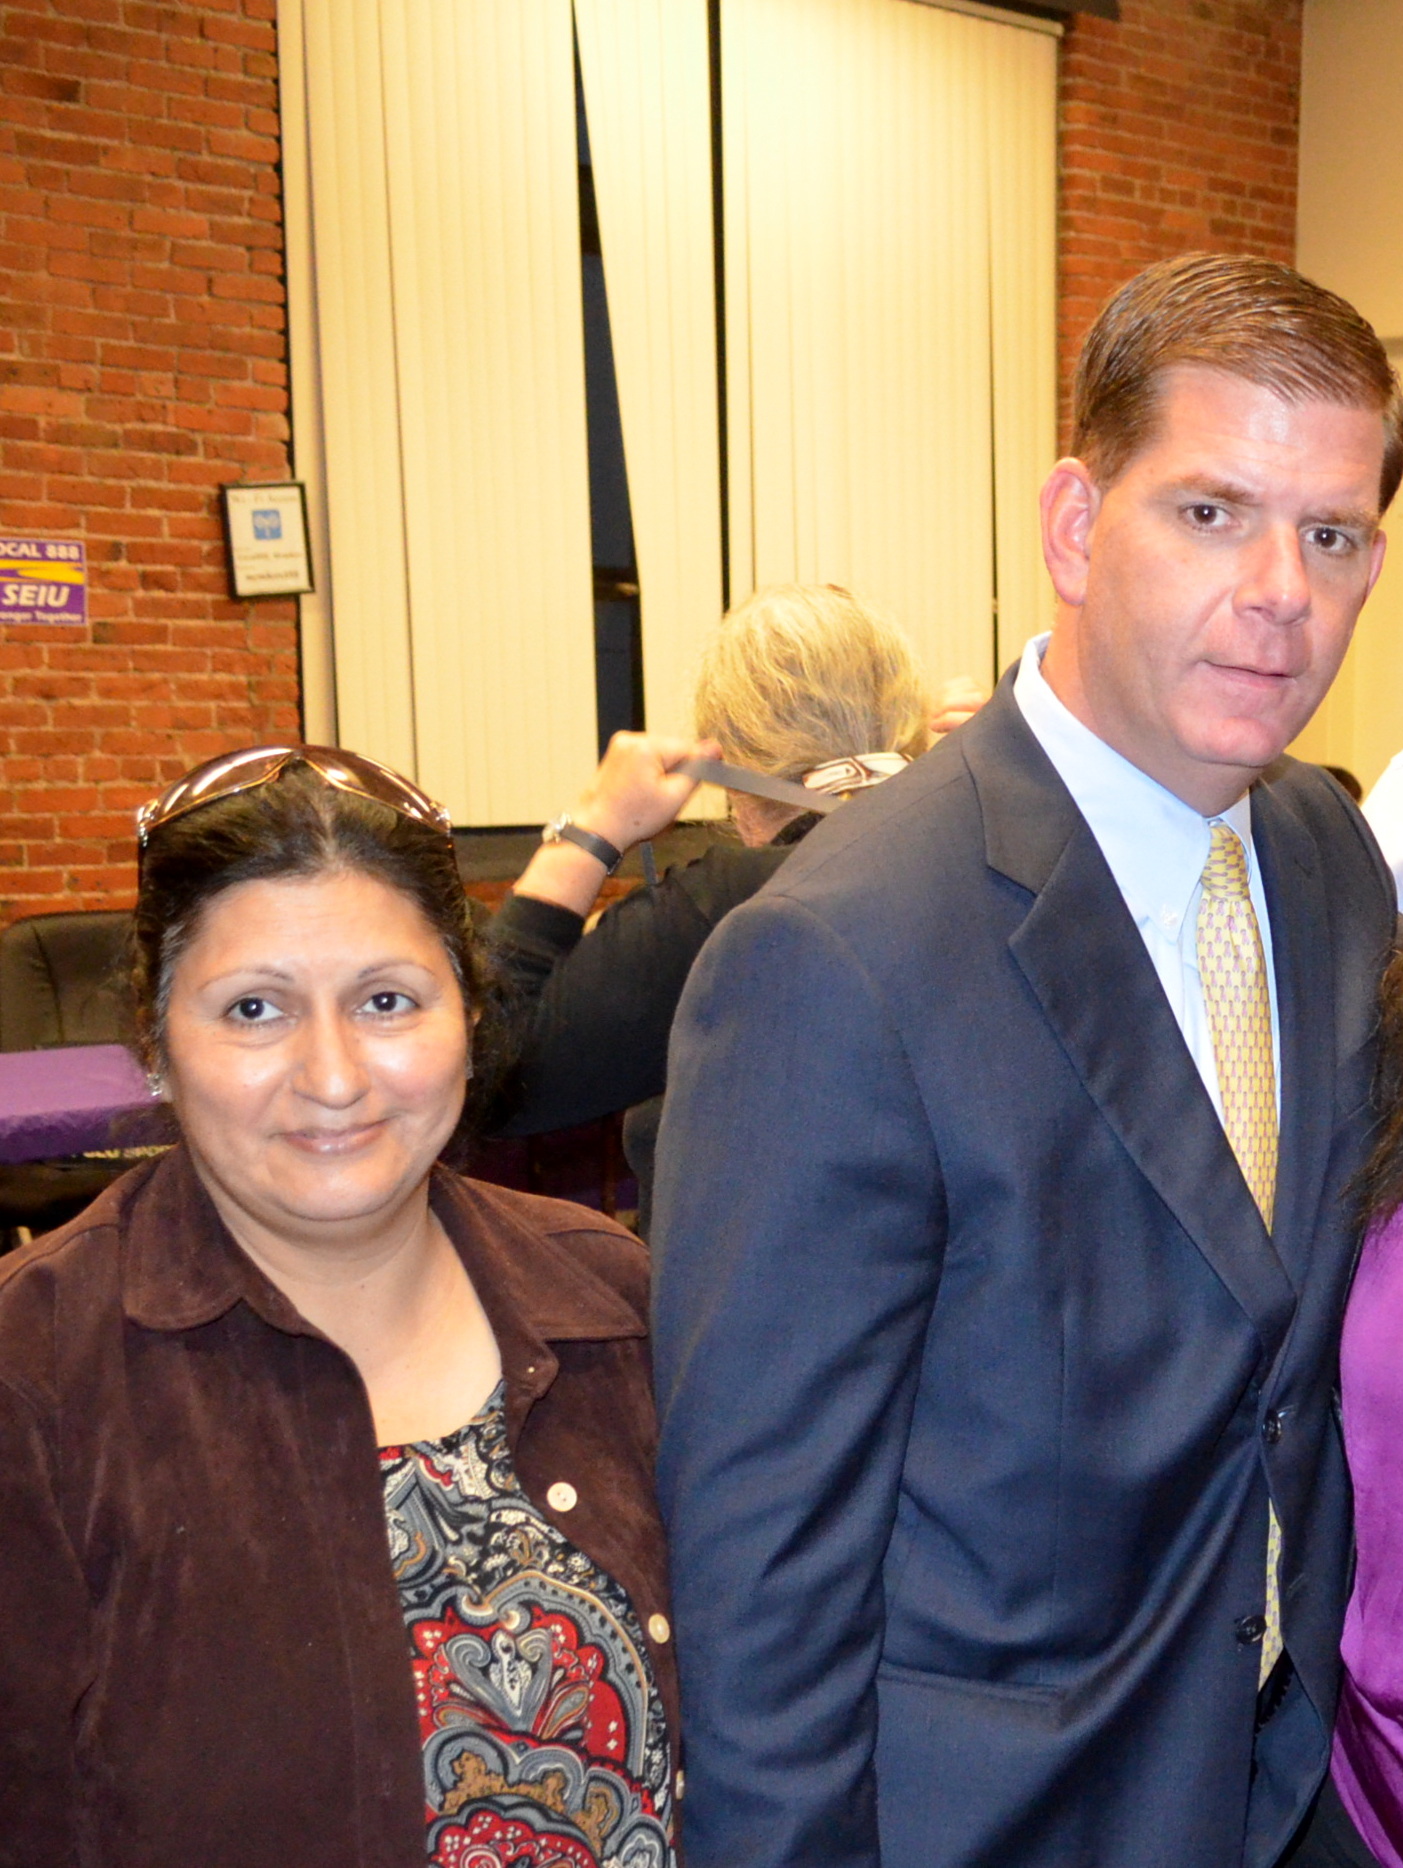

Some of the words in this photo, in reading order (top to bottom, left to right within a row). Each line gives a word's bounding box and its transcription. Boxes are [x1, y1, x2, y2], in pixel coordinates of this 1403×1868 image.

[0, 542, 41, 558] OCAL
[45, 544, 80, 559] 888
[1, 584, 70, 608] SEIU
